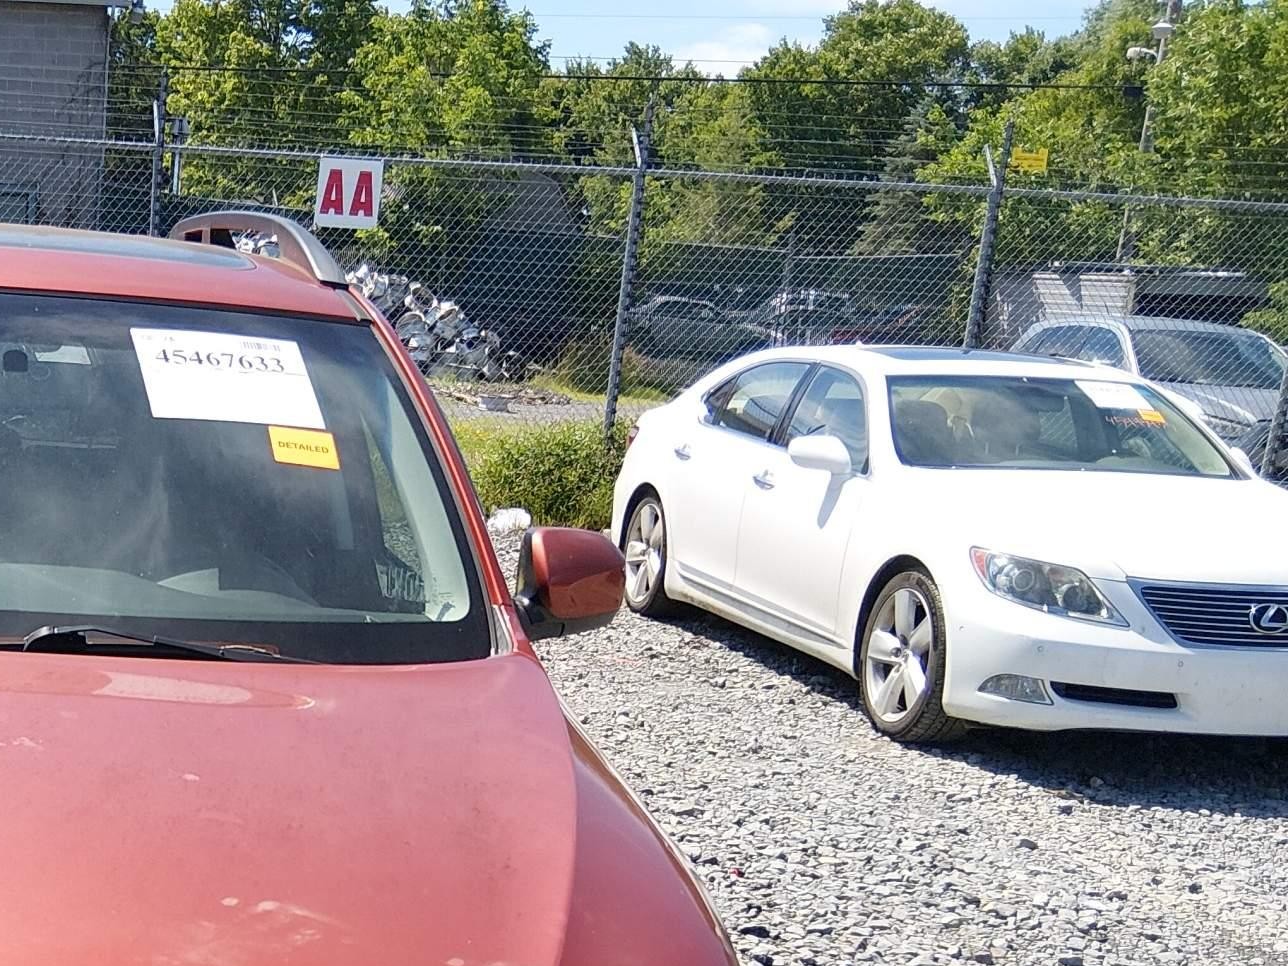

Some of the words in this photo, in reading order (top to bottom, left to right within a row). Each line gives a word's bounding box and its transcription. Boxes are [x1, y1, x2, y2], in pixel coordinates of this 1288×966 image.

[319, 168, 373, 217] AA
[154, 347, 286, 374] 45467633
[277, 440, 329, 455] DETAILED
